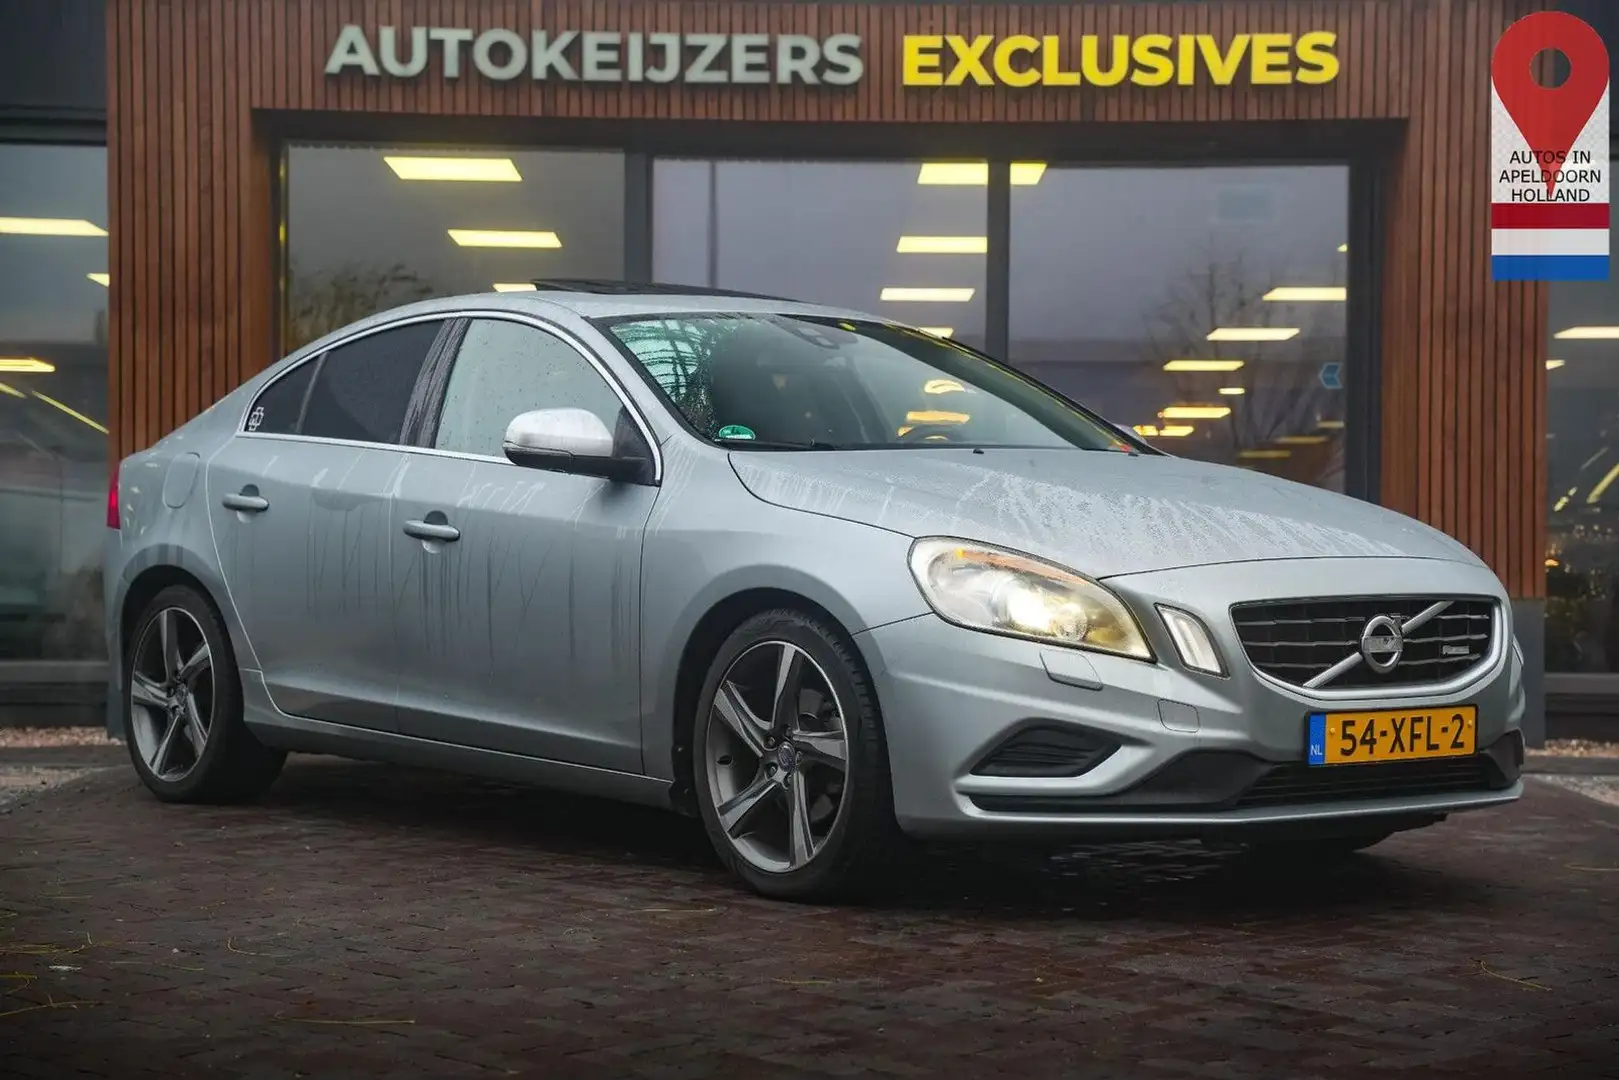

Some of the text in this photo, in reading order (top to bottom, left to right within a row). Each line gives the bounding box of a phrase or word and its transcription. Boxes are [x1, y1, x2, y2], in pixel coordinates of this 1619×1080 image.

[324, 24, 1340, 87] AUTOKEIJZERS EXCLUSIVES
[1310, 744, 1323, 756] NL
[1340, 713, 1465, 756] 54-XFL-2
